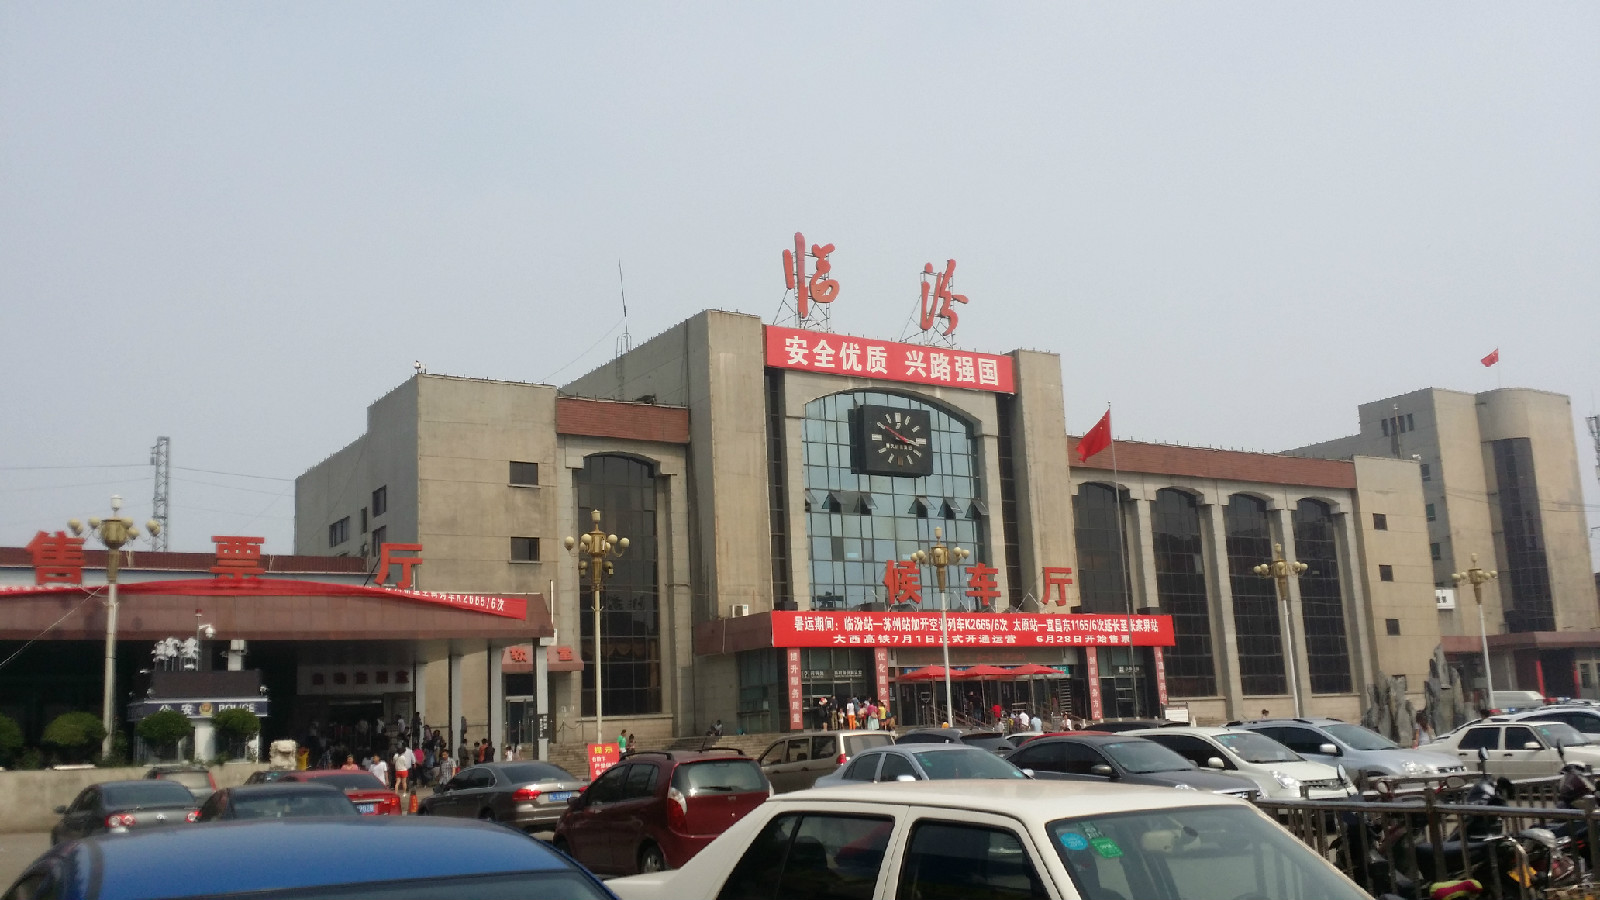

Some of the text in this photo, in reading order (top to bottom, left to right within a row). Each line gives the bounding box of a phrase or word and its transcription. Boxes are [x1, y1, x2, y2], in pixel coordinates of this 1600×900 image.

[782, 231, 969, 337] 临汾
[784, 335, 999, 386] 安全优质 兴路强国
[25, 531, 423, 588] 售票厅
[883, 559, 1074, 606] 候车厅
[159, 703, 196, 715] 公安
